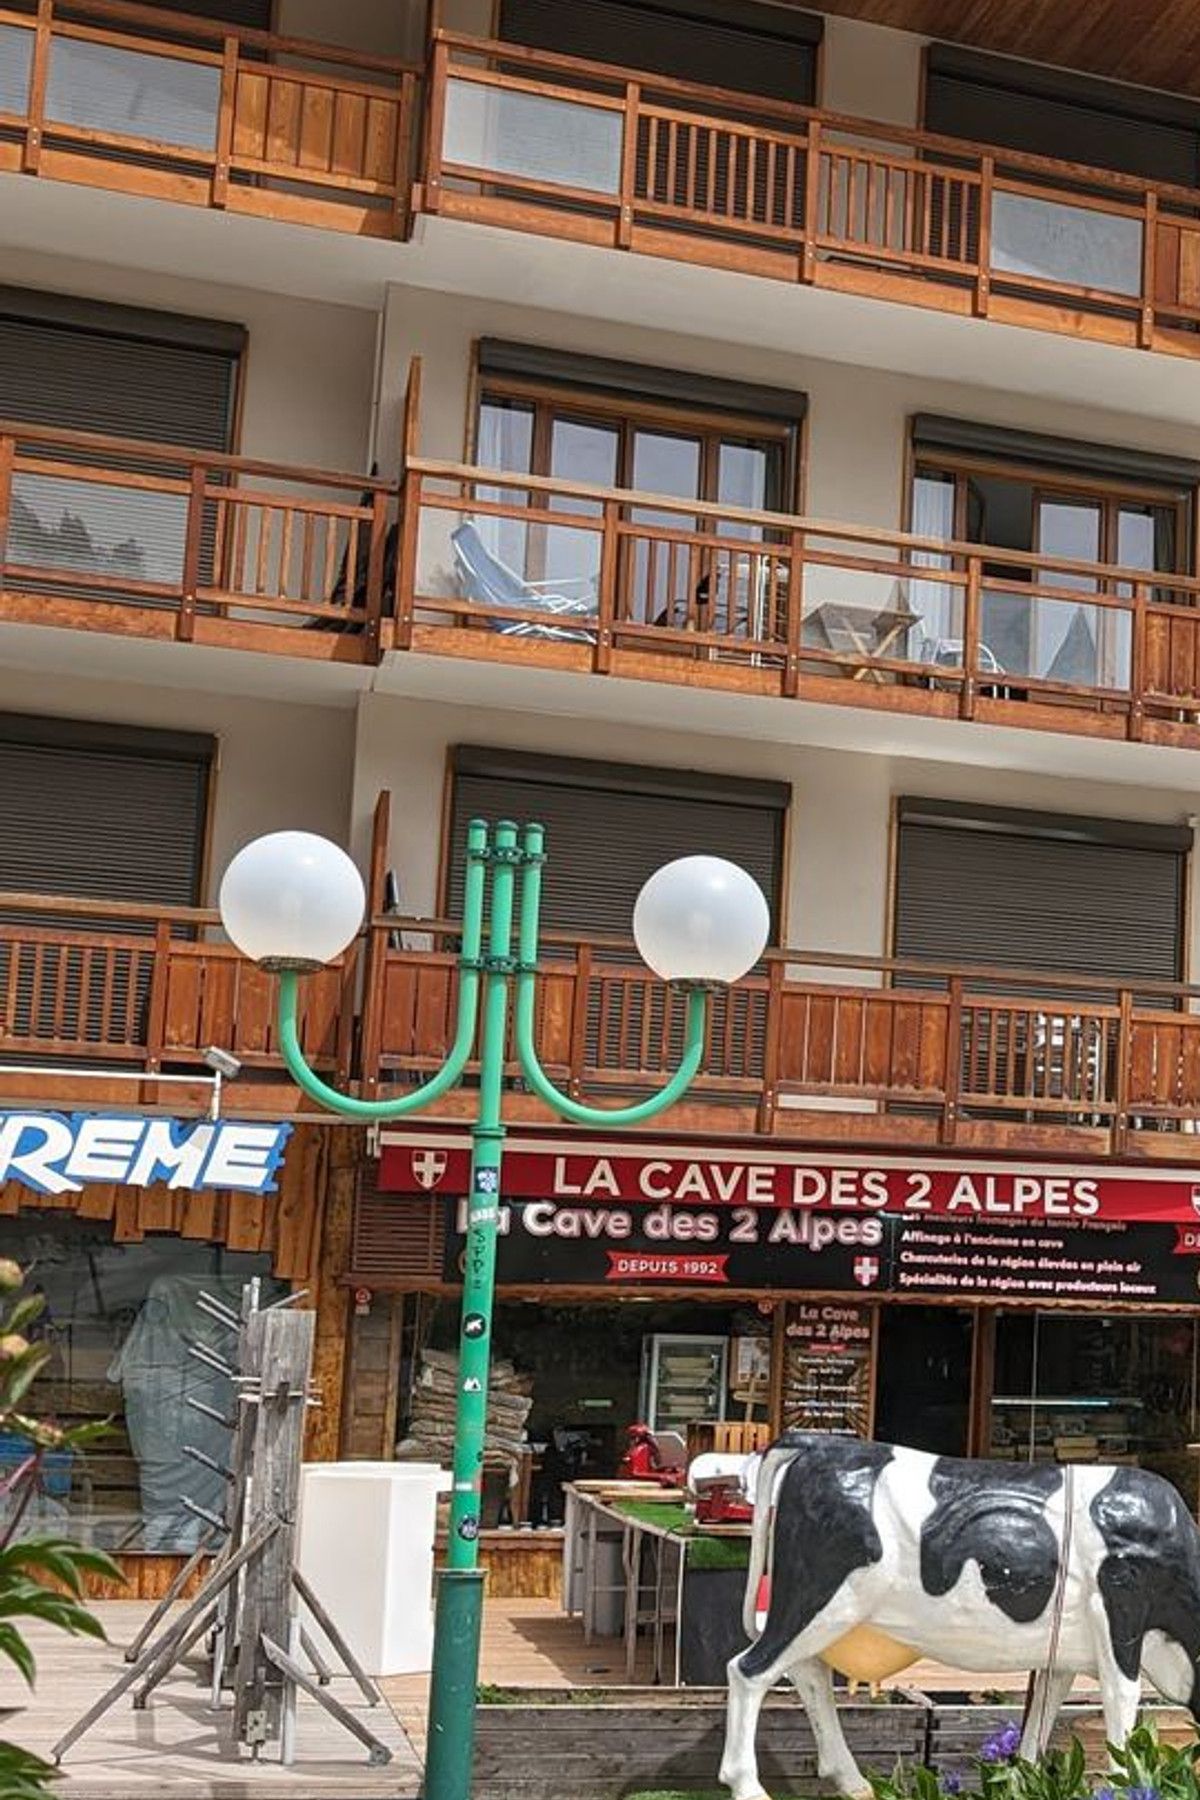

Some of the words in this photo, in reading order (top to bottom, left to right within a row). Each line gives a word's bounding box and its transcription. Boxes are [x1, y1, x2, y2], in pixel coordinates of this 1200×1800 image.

[0, 1114, 280, 1194] REME
[553, 1157, 621, 1196] LA
[638, 1161, 776, 1203] CAVE
[793, 1167, 889, 1207] DES
[904, 1172, 932, 1209] 2
[947, 1174, 1100, 1216] ALPES
[522, 1202, 632, 1238] Cave
[643, 1205, 719, 1242] des
[729, 1208, 759, 1243] 2
[768, 1210, 884, 1251] Alpes
[618, 1260, 679, 1274] DEPUIS
[682, 1262, 718, 1275] 1992
[971, 1254, 985, 1266] de
[960, 1275, 974, 1286] de
[800, 1306, 819, 1320] La
[821, 1306, 859, 1321] Cave
[786, 1323, 812, 1337] des
[816, 1324, 827, 1337] 2
[829, 1325, 870, 1341] Alpes
